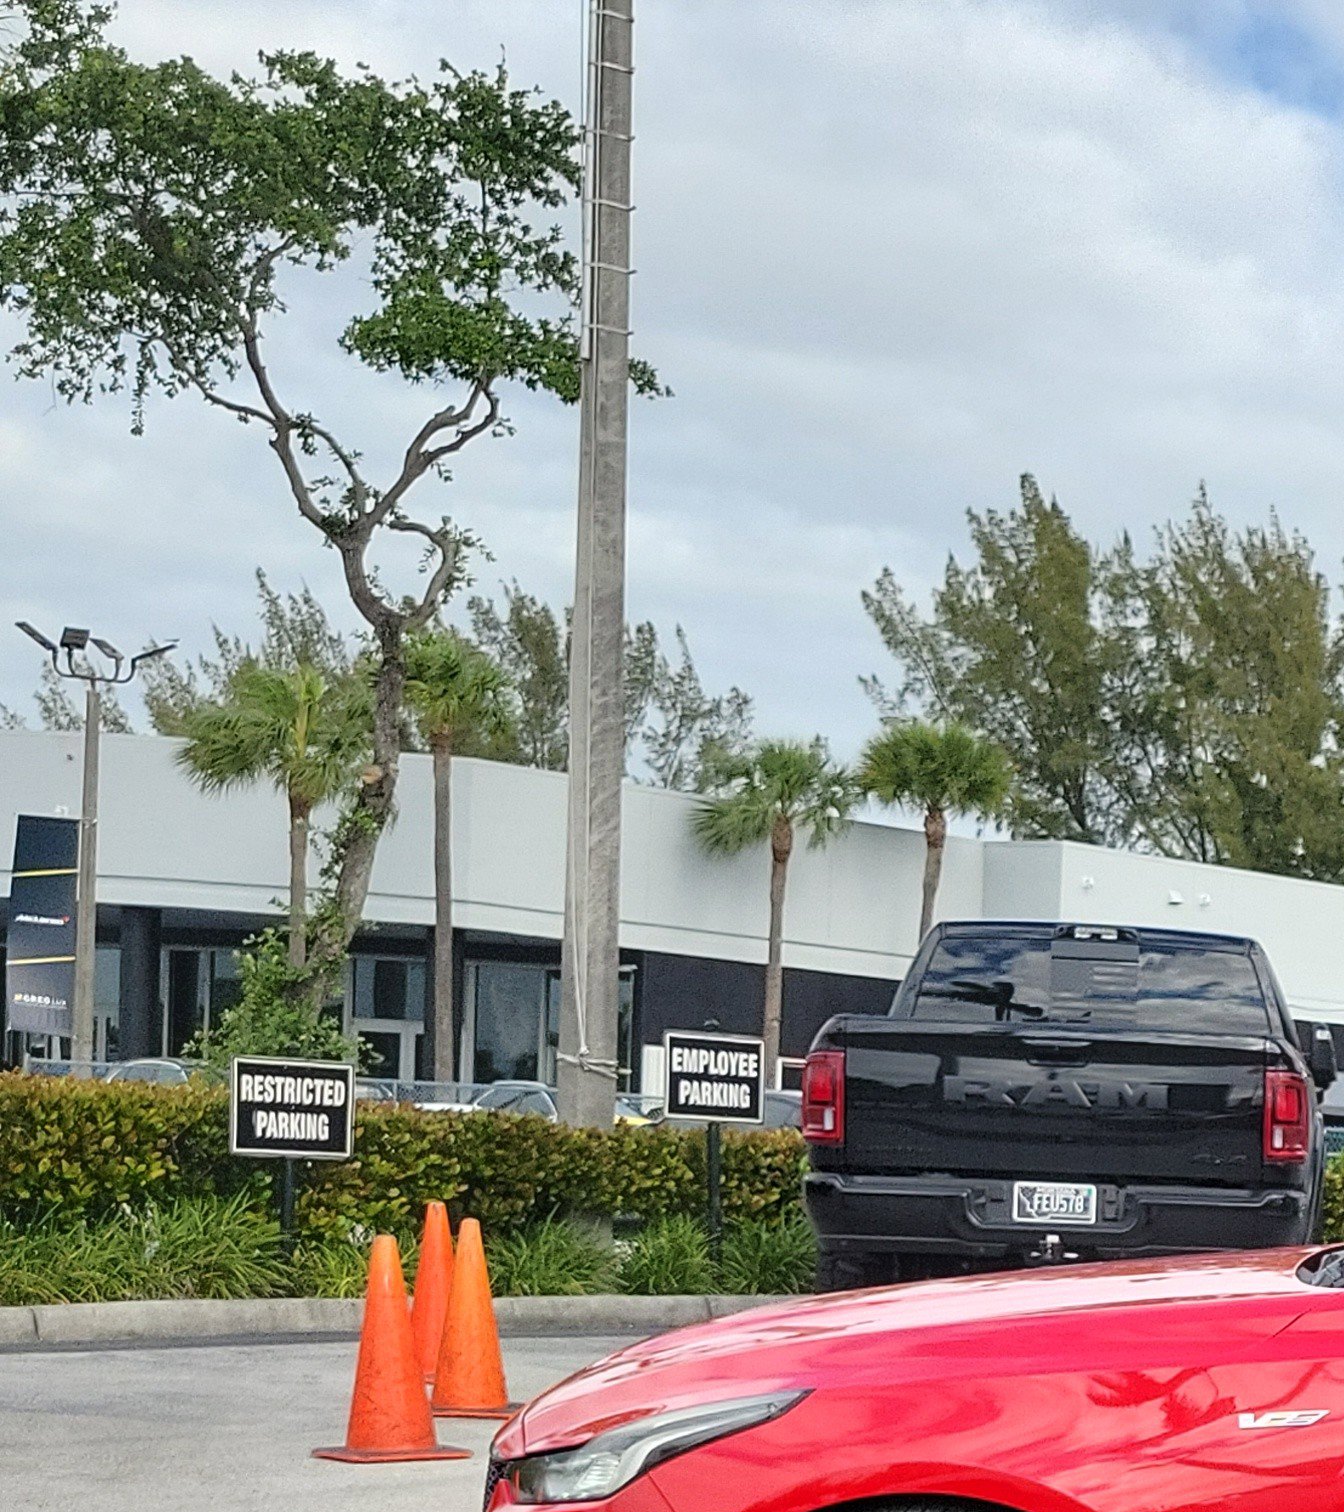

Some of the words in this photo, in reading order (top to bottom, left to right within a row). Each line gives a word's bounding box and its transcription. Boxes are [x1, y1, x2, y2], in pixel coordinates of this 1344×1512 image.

[672, 1047, 758, 1077] EMPLOYEE
[240, 1073, 346, 1107] RESTRICTED
[678, 1079, 751, 1109] PARKING
[943, 1074, 1168, 1109] RAM
[255, 1110, 330, 1141] PARKING
[1033, 1193, 1084, 1213] FEU578
